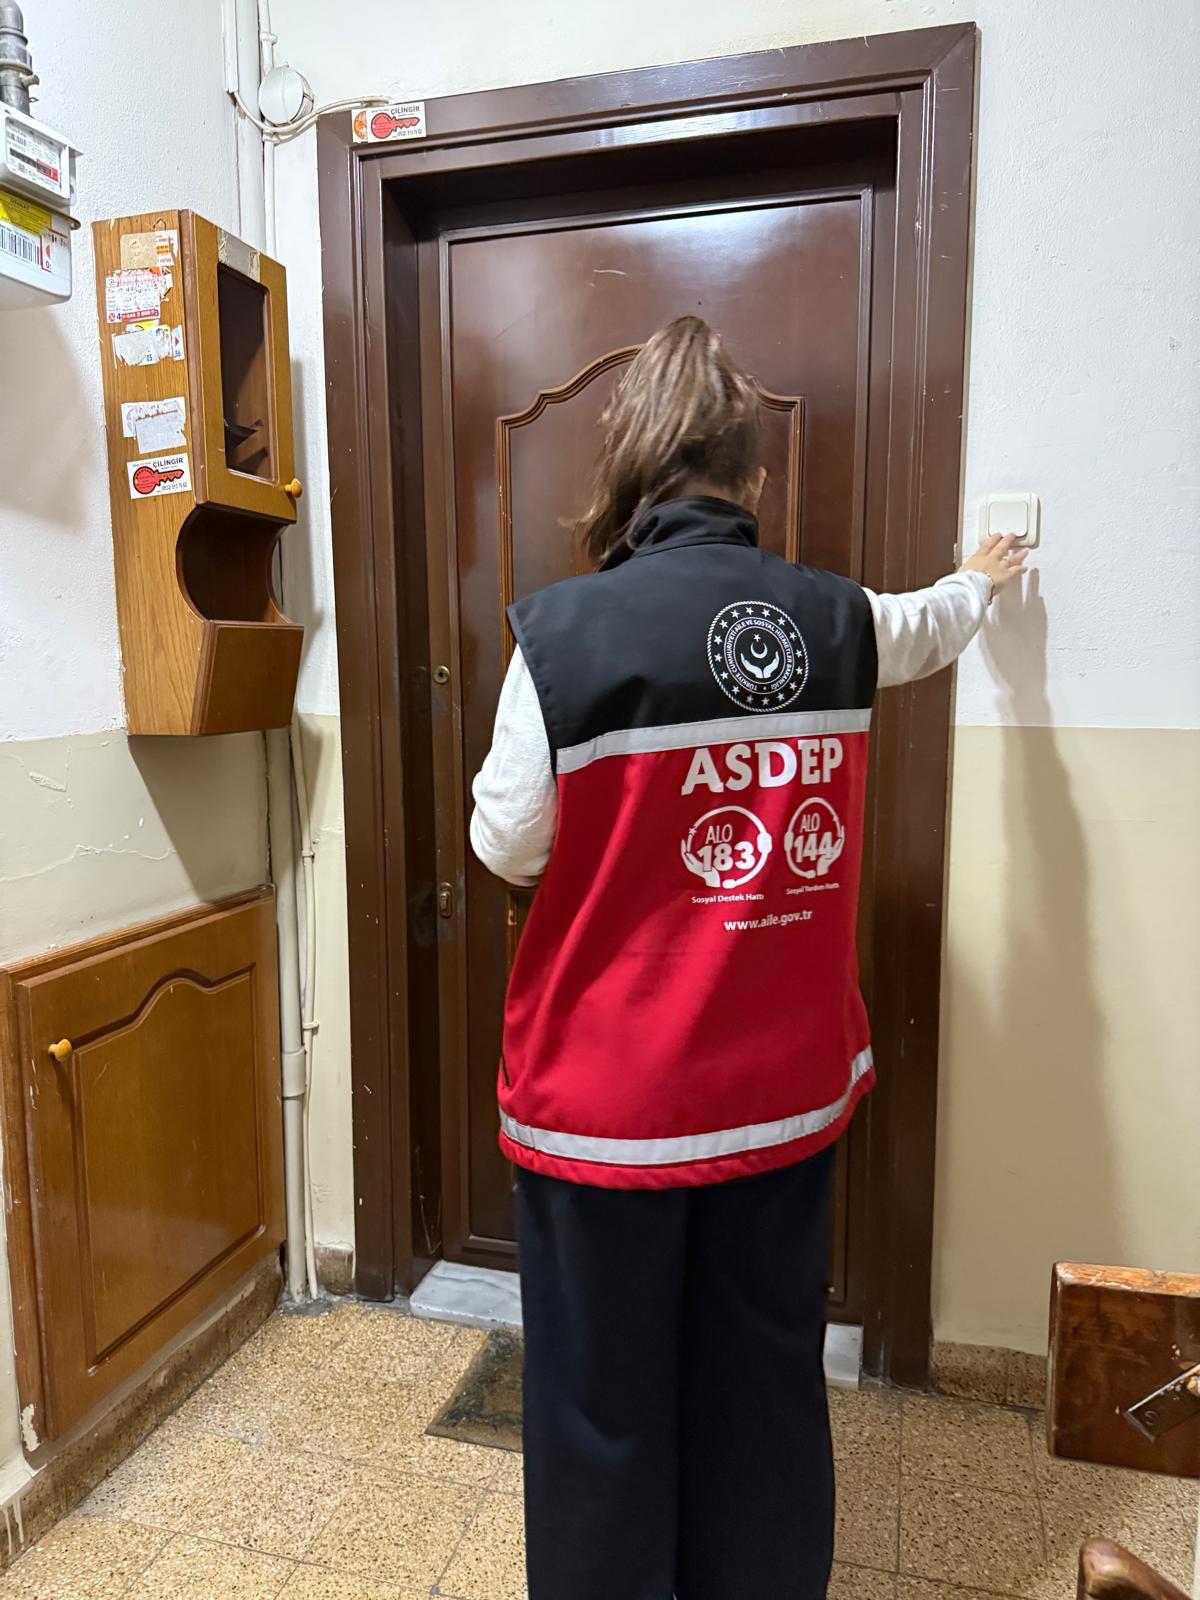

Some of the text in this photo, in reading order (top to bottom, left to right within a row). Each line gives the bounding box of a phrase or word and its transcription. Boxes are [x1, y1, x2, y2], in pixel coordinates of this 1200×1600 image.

[390, 105, 421, 115] ÇİLİNGİR
[152, 457, 184, 469] ÇİLİNGİR
[753, 619, 775, 632] SOSYAL
[681, 738, 843, 795] ASDEP
[800, 812, 821, 832] ALO
[705, 824, 733, 845] ALO
[697, 841, 756, 872] 183
[793, 831, 834, 863] 144
[691, 893, 765, 904] Sosyal Destek Hattı
[724, 910, 813, 931] www.aile.gov.tr
